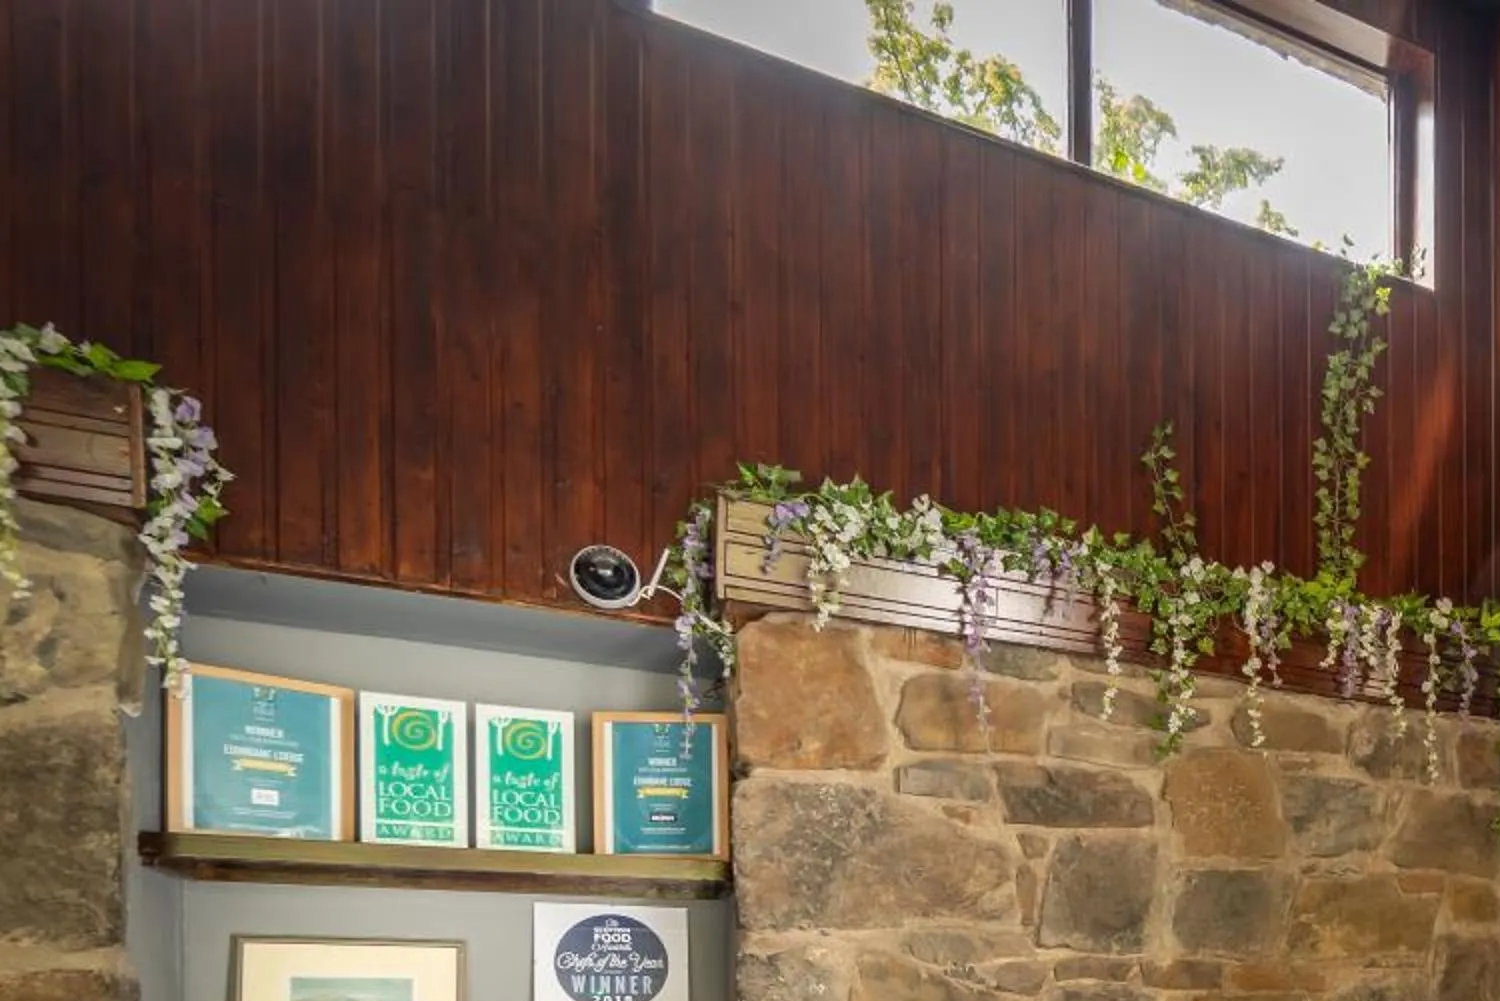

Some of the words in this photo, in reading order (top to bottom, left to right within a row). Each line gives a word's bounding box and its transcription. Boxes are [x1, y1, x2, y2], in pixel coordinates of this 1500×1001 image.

[379, 780, 451, 800] LOCAL
[492, 788, 560, 809] LOCAL
[379, 798, 451, 817] FOOD
[493, 805, 561, 824] FOOD
[593, 933, 632, 944] FOOD
[571, 974, 653, 994] WINNER
